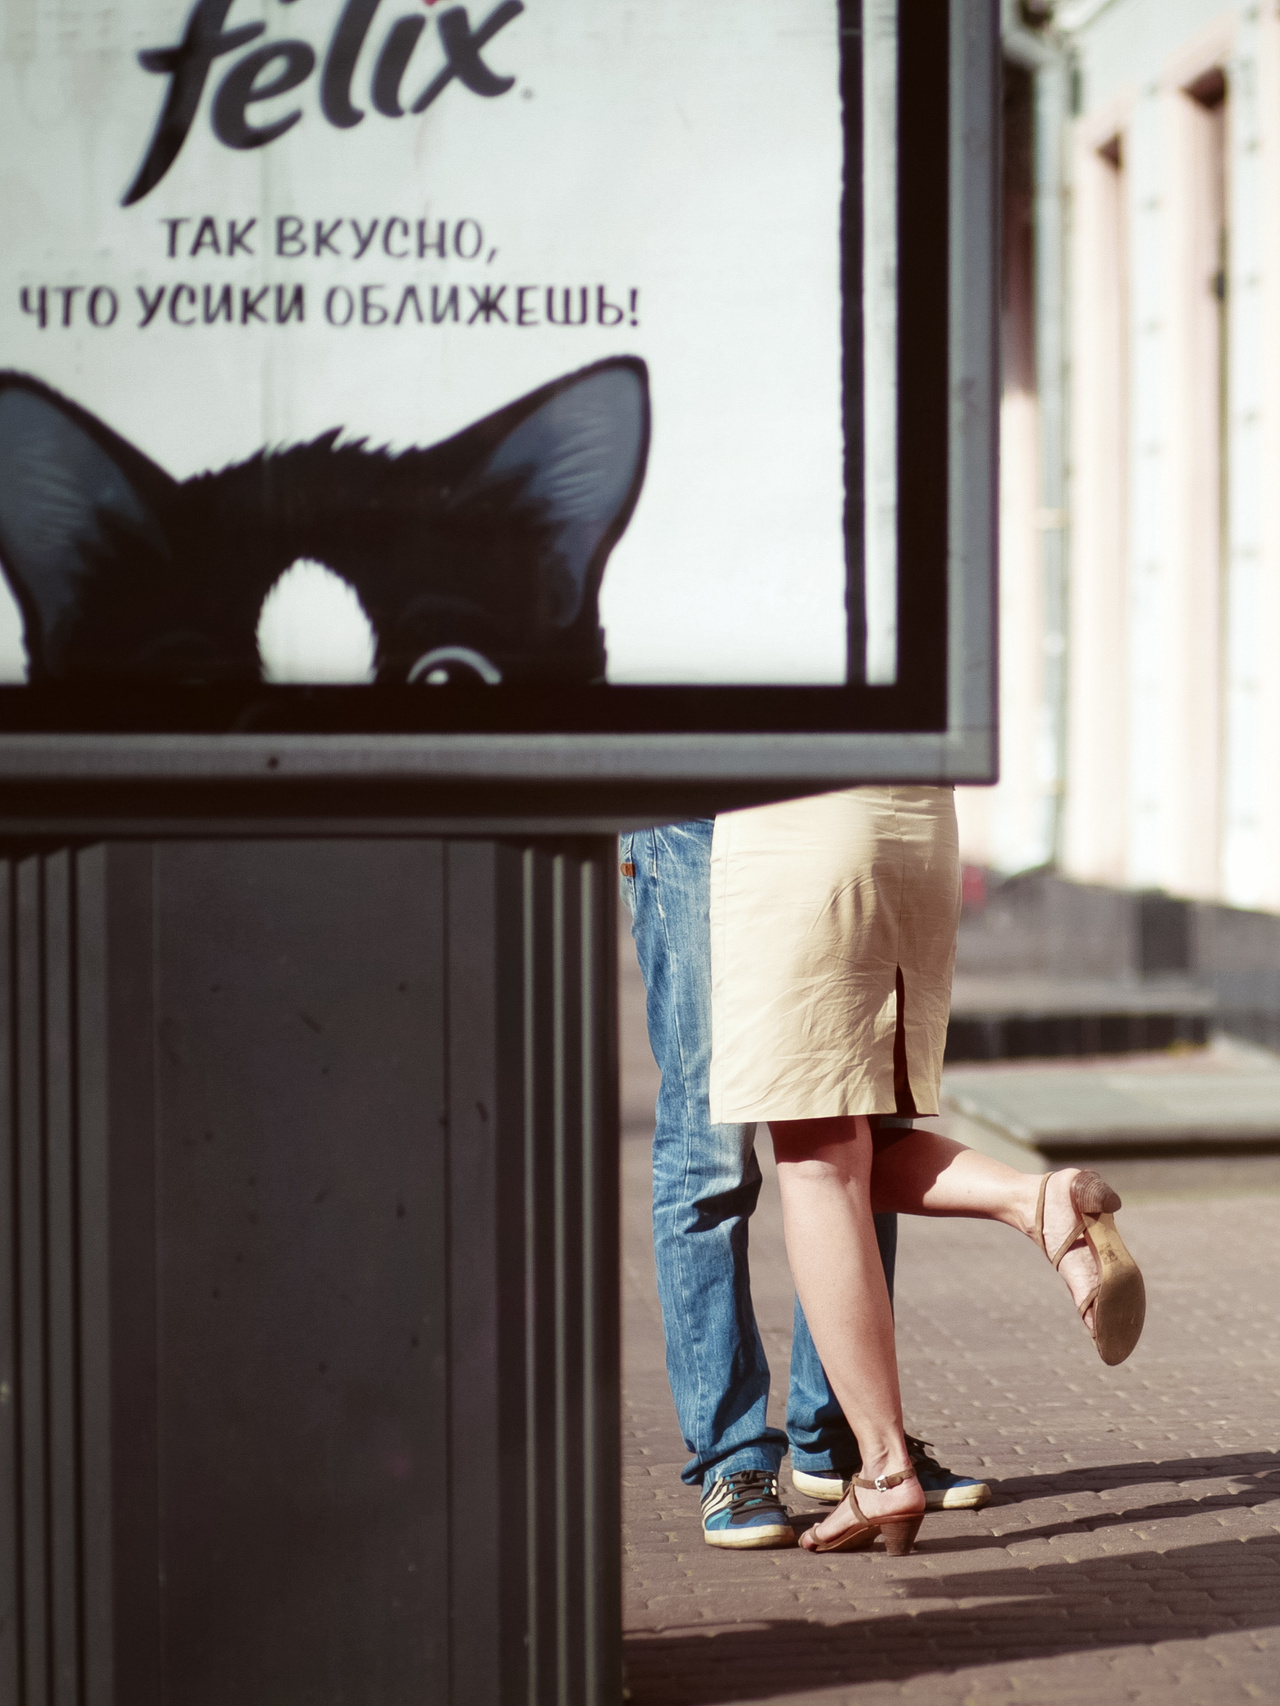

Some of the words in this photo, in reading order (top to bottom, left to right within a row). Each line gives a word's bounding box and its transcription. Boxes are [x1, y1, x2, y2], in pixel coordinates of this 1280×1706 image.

[161, 215, 257, 259] ТАК
[274, 215, 499, 265] ВКУСНО,
[19, 285, 119, 329] ЧТО
[136, 282, 306, 329] УСИКИ
[324, 284, 640, 328] ОБЛИЖЕШЬ!
